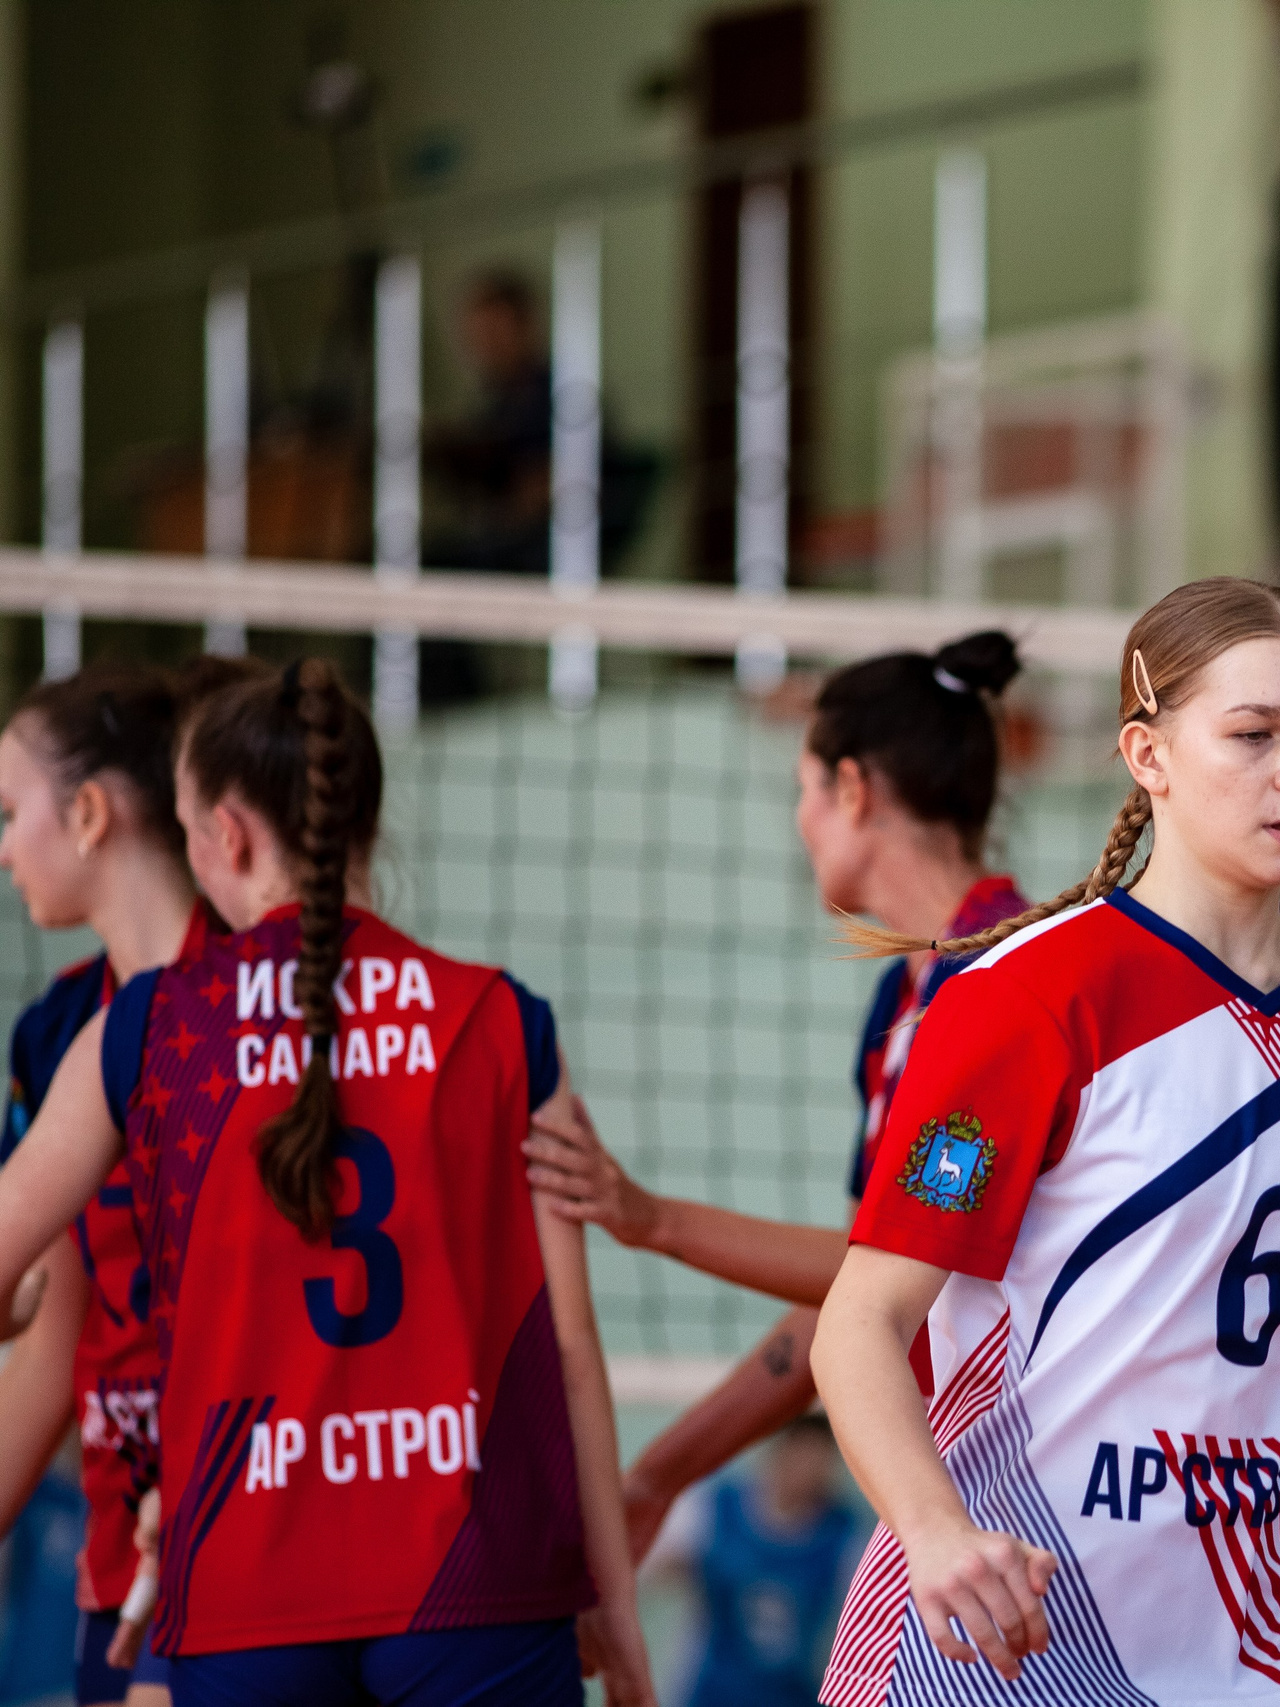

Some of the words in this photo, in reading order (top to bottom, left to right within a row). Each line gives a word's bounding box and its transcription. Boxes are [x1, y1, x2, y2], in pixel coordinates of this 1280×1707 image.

[303, 1125, 404, 1348] 3
[245, 1416, 307, 1494] АР
[1080, 1441, 1168, 1522] АР
